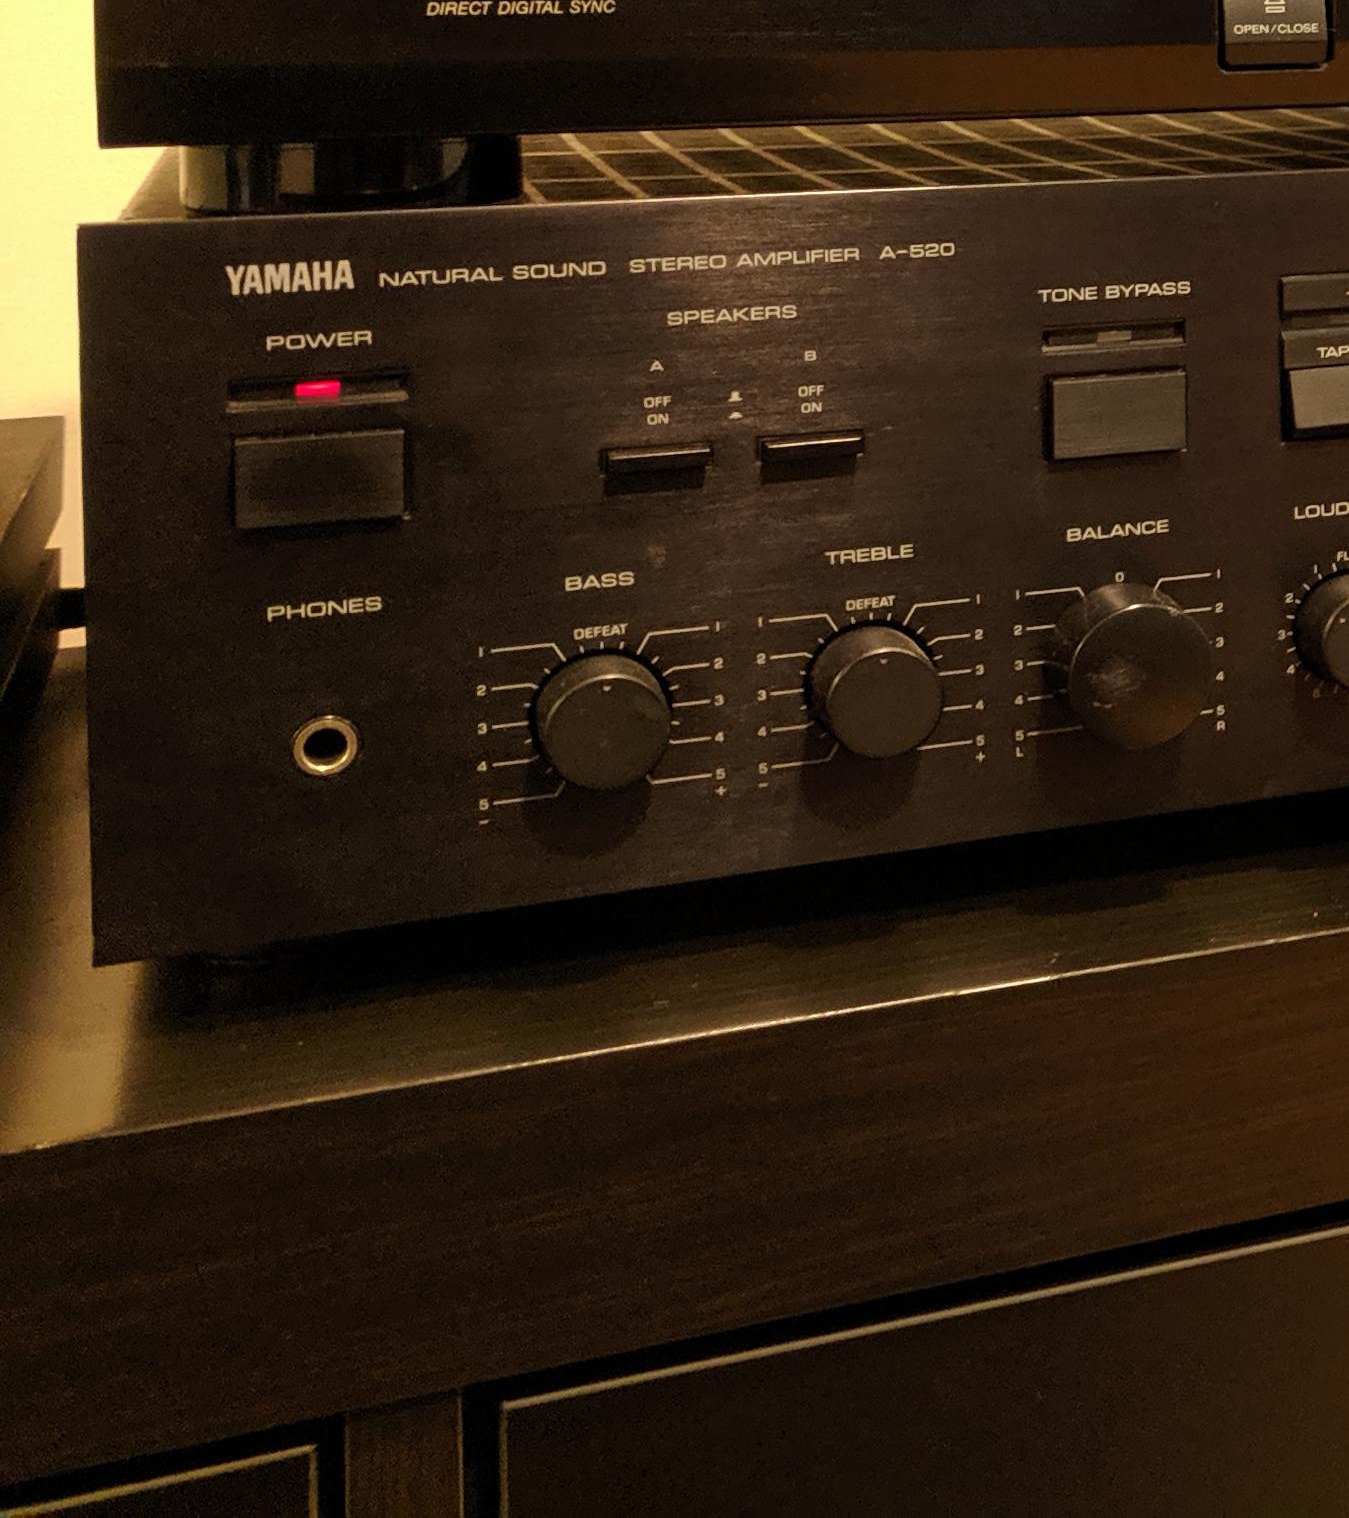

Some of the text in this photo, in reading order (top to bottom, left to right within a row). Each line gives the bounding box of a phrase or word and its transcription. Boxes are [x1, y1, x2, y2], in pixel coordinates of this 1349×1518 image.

[425, 0, 616, 16] DIRECT DIGITAL SYNC
[1233, 22, 1319, 35] OPEN/CLOSE
[225, 242, 955, 296] YAMAHA NATURAL SOUND STEREO AMPLIFIER A-520
[1038, 280, 1192, 305] TONE BYPASS
[667, 304, 798, 326] SPEAKERS
[266, 330, 373, 351] POWER
[804, 350, 817, 362] B
[650, 360, 664, 373] A
[798, 385, 824, 398] OFF
[643, 395, 672, 409] OFF
[801, 401, 822, 414] ON
[647, 412, 669, 426] ON
[1066, 519, 1170, 542] BALANCE
[824, 544, 915, 566] TREBLE
[564, 571, 635, 592] BASS
[266, 596, 383, 622] PHONES
[845, 595, 895, 612] DEFEAT
[573, 622, 628, 641] DEFEAT
